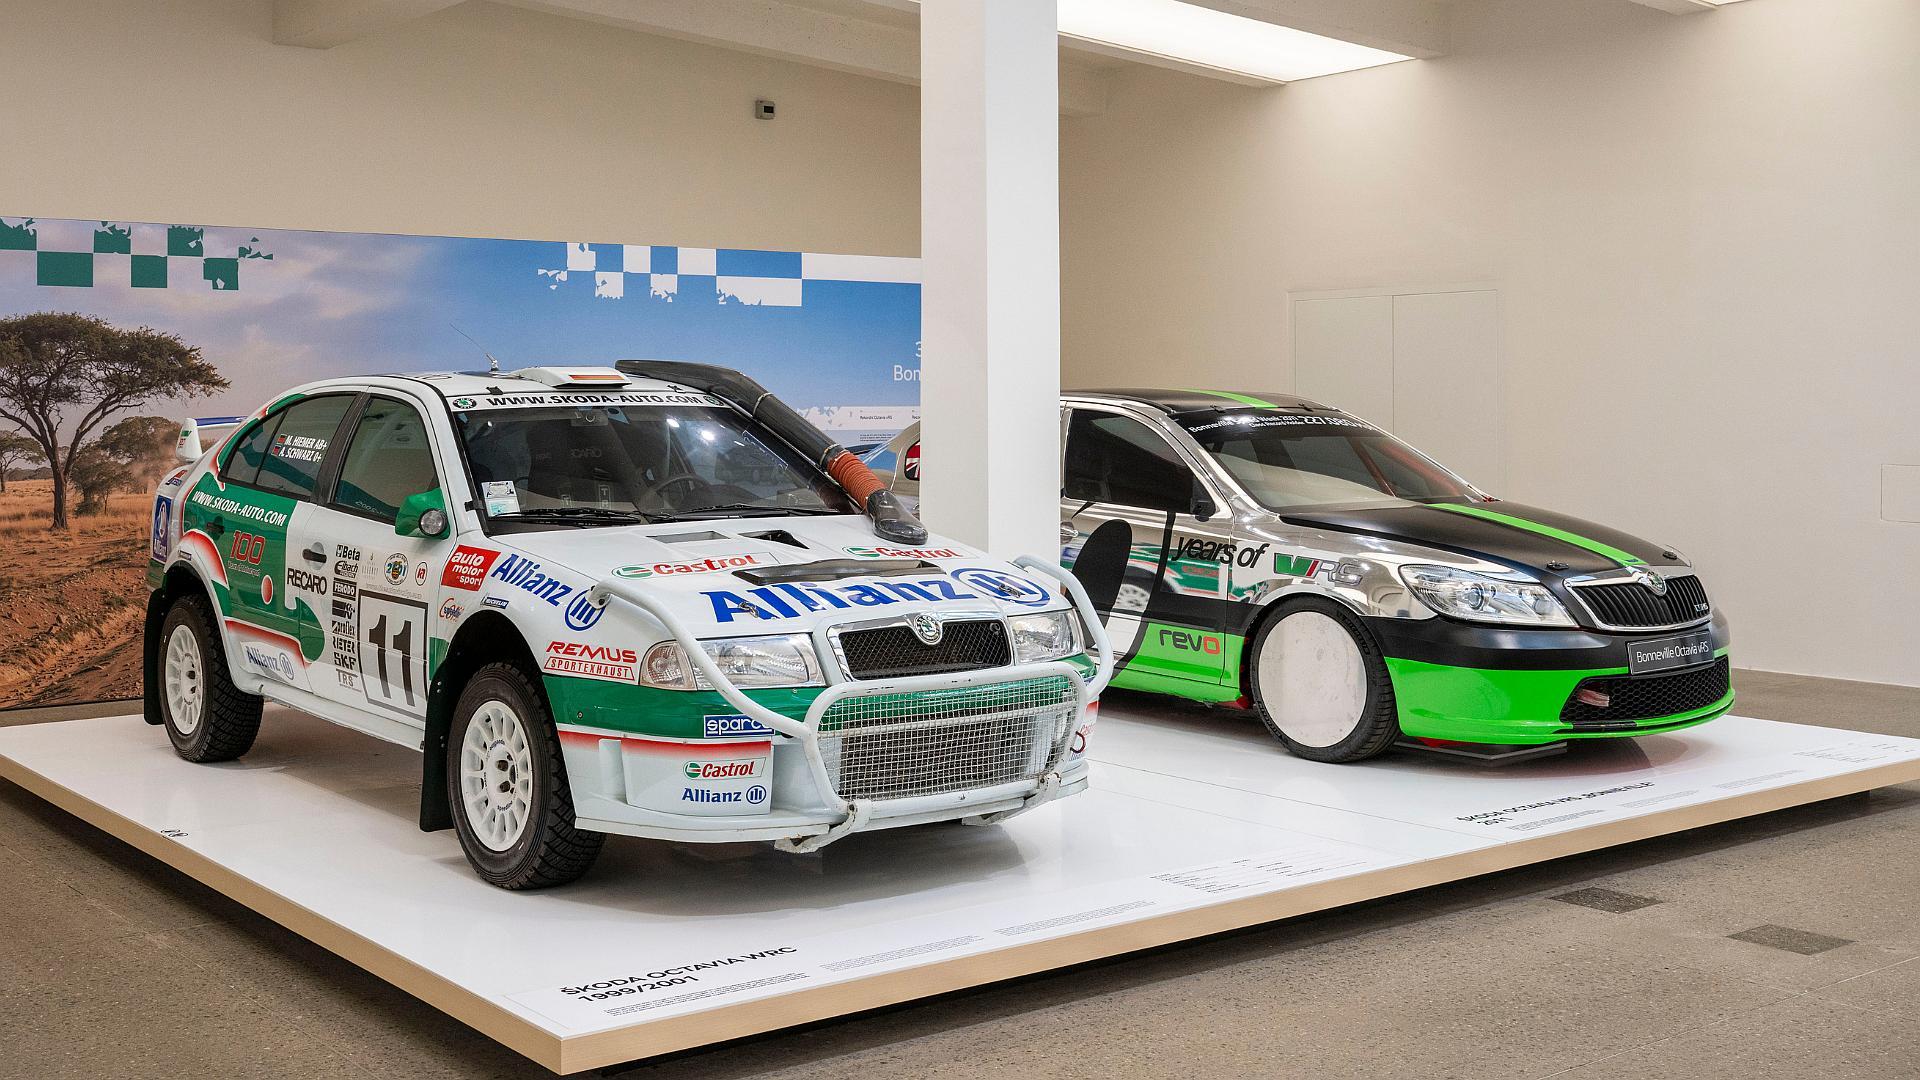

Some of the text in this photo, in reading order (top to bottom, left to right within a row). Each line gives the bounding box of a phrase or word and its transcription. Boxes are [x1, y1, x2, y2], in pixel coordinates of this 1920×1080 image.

[485, 394, 702, 407] WWW.SKODA-AUTO.COM
[192, 490, 287, 527] WWW.SKODA-AUTO.COM
[230, 529, 265, 566] 100
[342, 545, 361, 561] Beta
[875, 547, 963, 559] Castrol
[1171, 536, 1270, 569] years of
[452, 552, 485, 567] auto
[452, 564, 484, 577] motor
[653, 554, 762, 576] Castrol
[287, 567, 328, 596] RECARO
[334, 582, 356, 597] FERODO
[458, 574, 482, 586] sport
[490, 553, 574, 607] Allianz
[700, 578, 976, 623] Allianz
[546, 641, 638, 664] REMUS
[1159, 629, 1221, 655] revo
[1636, 641, 1709, 663] Bonneville Octavia vRS
[333, 651, 358, 671] SKF
[368, 614, 416, 707] 11
[550, 658, 630, 678] SPORTEXHAUST
[706, 718, 769, 736] sparc
[702, 760, 755, 778] Castrol
[682, 786, 743, 803] Allianz
[559, 975, 648, 996] ŠKODA
[646, 956, 746, 979] OCTAVIA
[741, 946, 798, 961] WRC
[577, 975, 701, 1002] 1999/2001
